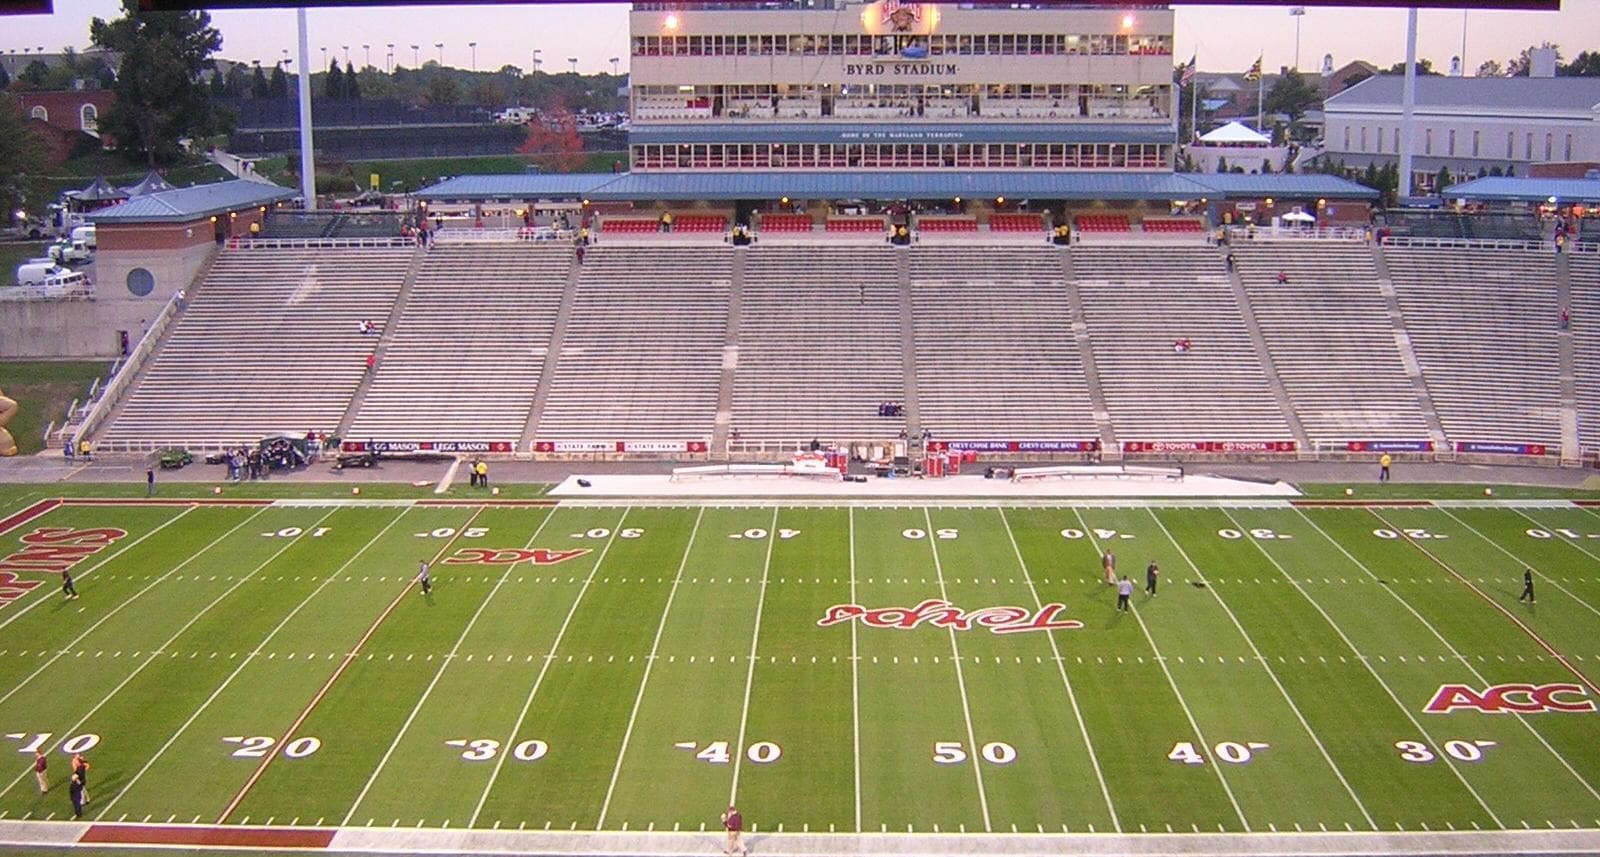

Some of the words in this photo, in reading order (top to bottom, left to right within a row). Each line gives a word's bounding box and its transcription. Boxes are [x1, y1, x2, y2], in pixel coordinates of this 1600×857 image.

[847, 64, 885, 75] BYRD
[893, 64, 957, 75] STADIUM
[388, 443, 421, 451] MASON
[457, 442, 490, 450] MASON
[948, 442, 968, 450] CHEVY
[990, 442, 1008, 450] BANK
[1018, 442, 1039, 450] CHEVY
[1060, 442, 1078, 450] BANK
[441, 548, 593, 565] ACC
[817, 599, 1084, 632] Terps
[1422, 683, 1598, 713] ACC
